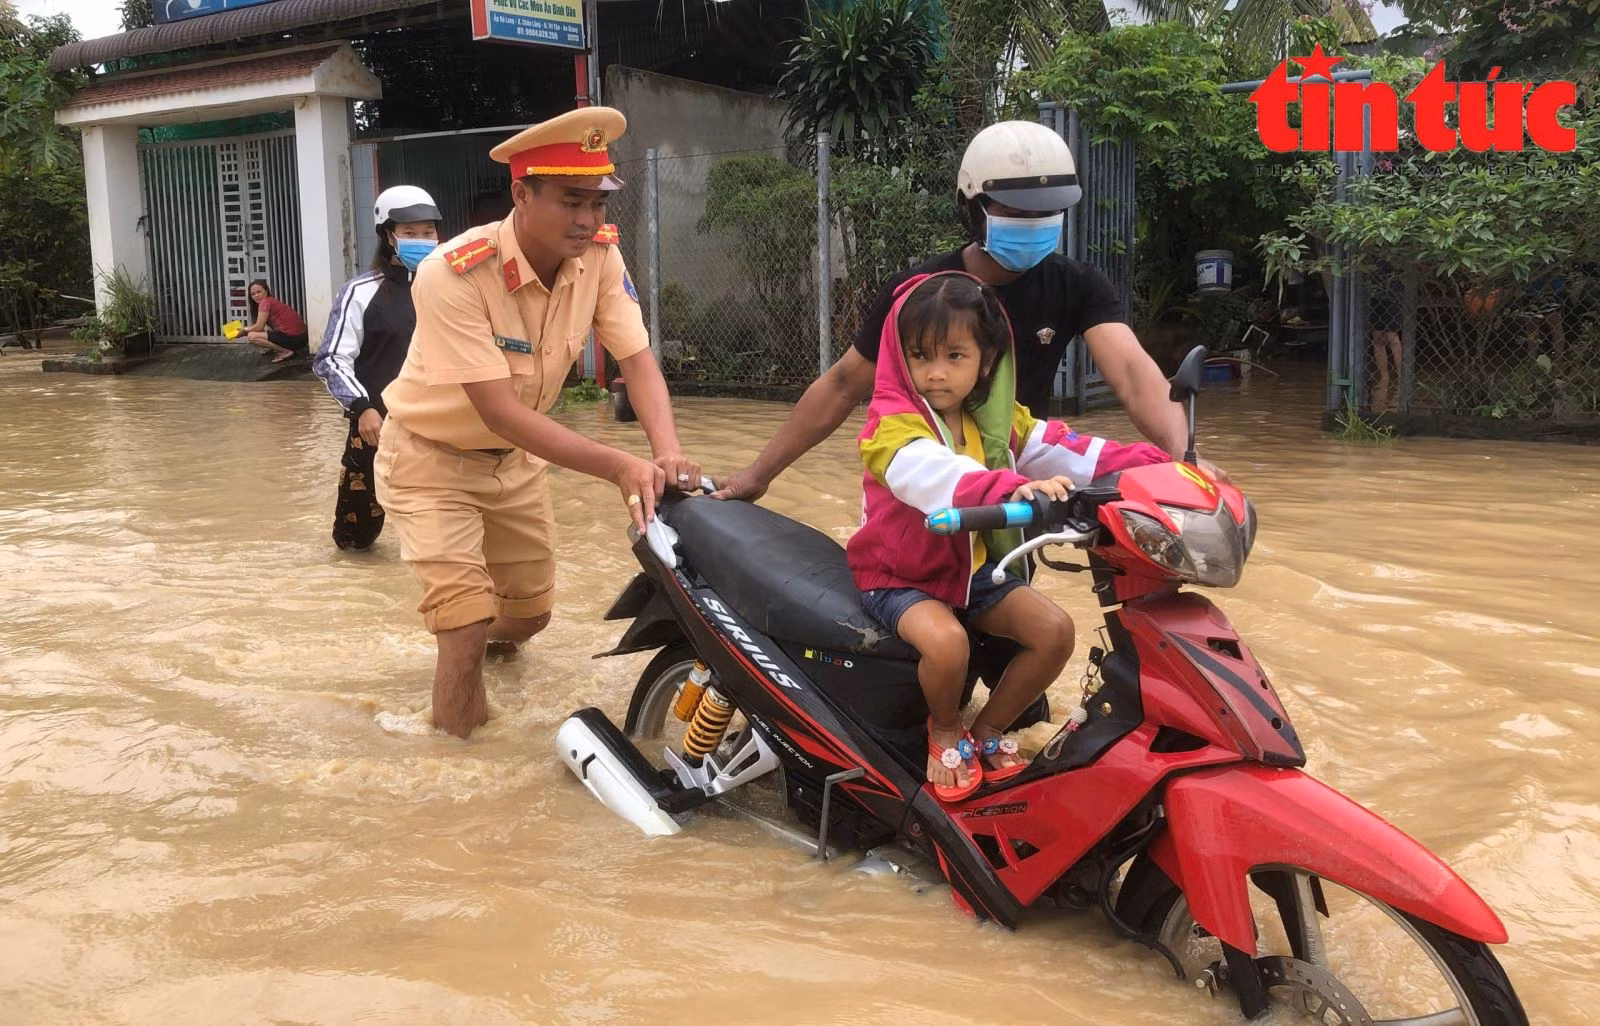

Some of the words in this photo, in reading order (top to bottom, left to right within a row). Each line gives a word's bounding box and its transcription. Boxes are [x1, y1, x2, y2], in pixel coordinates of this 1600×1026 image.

[702, 597, 802, 690] SIRIUS
[752, 713, 771, 733] FUEL
[772, 733, 814, 769] INJECTION
